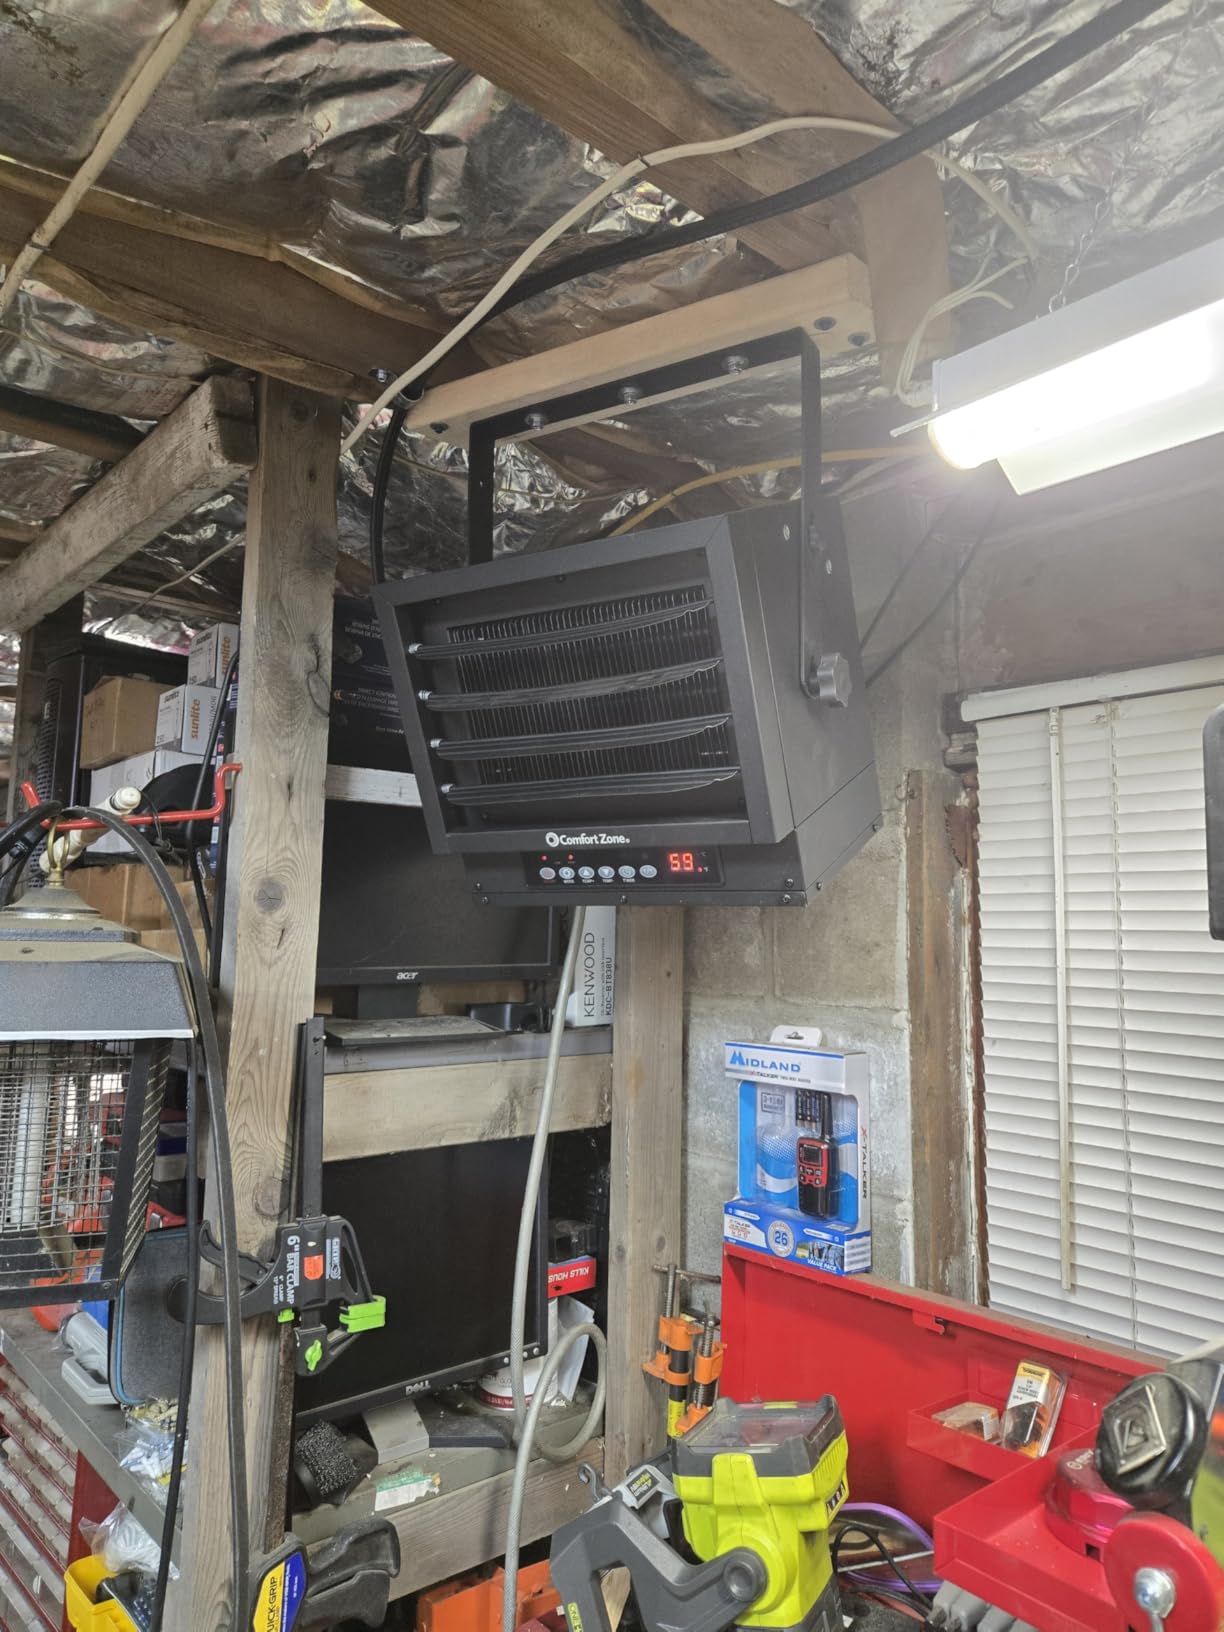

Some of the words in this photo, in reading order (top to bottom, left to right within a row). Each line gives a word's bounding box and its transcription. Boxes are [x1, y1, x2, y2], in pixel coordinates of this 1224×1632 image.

[190, 698, 201, 741] sunlite
[559, 833, 599, 846] Comfort
[599, 833, 625, 844] Zone
[669, 852, 694, 872] 59
[396, 971, 419, 980] acer
[584, 932, 595, 1018] KENWOOD
[729, 1049, 801, 1073] MIDLAND
[287, 1235, 301, 1252] 6"
[774, 1230, 788, 1246] 26
[287, 1252, 295, 1272] BAR
[570, 1266, 590, 1279] KILLS
[286, 1272, 295, 1305] CLAMP
[405, 1379, 431, 1396] DELL
